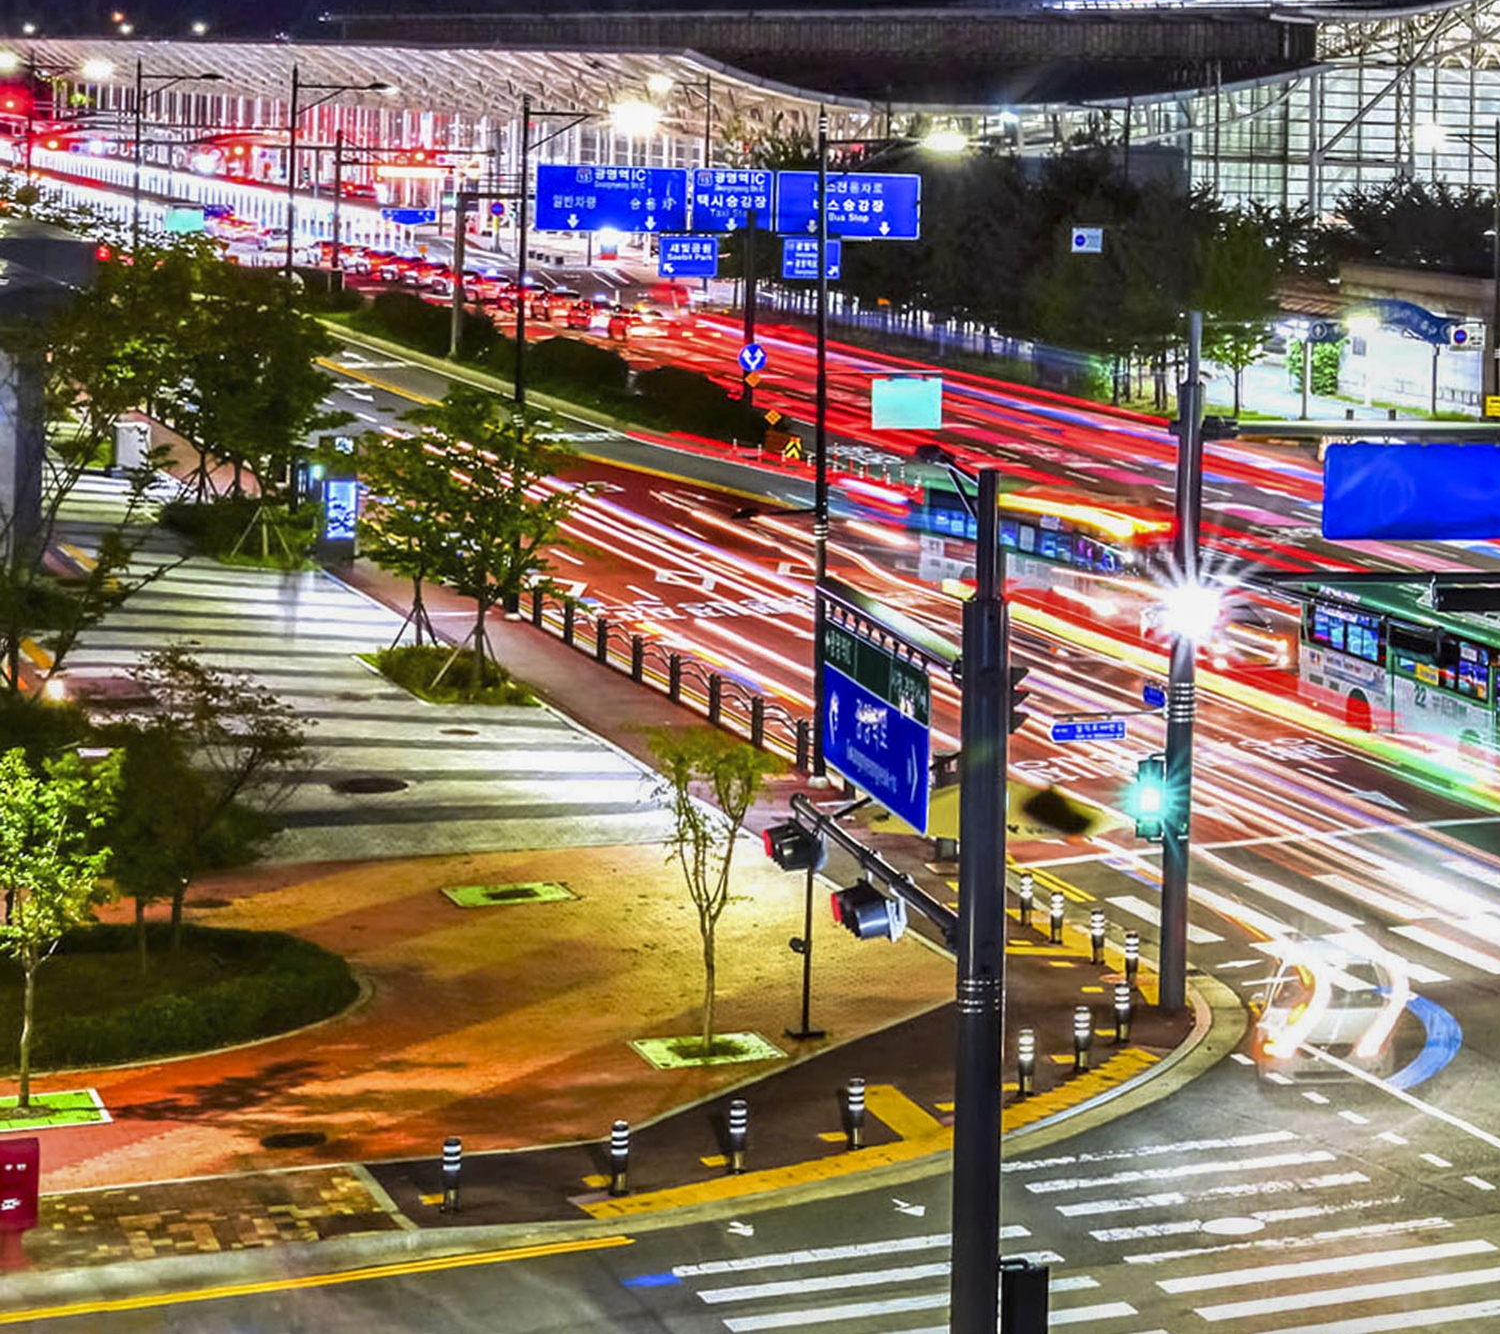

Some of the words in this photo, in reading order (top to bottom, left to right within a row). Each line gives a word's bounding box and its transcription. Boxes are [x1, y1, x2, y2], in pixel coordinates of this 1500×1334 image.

[594, 168, 647, 182] 광명역IC
[714, 171, 766, 185] 광명역IC
[697, 193, 768, 209] 택시승강장
